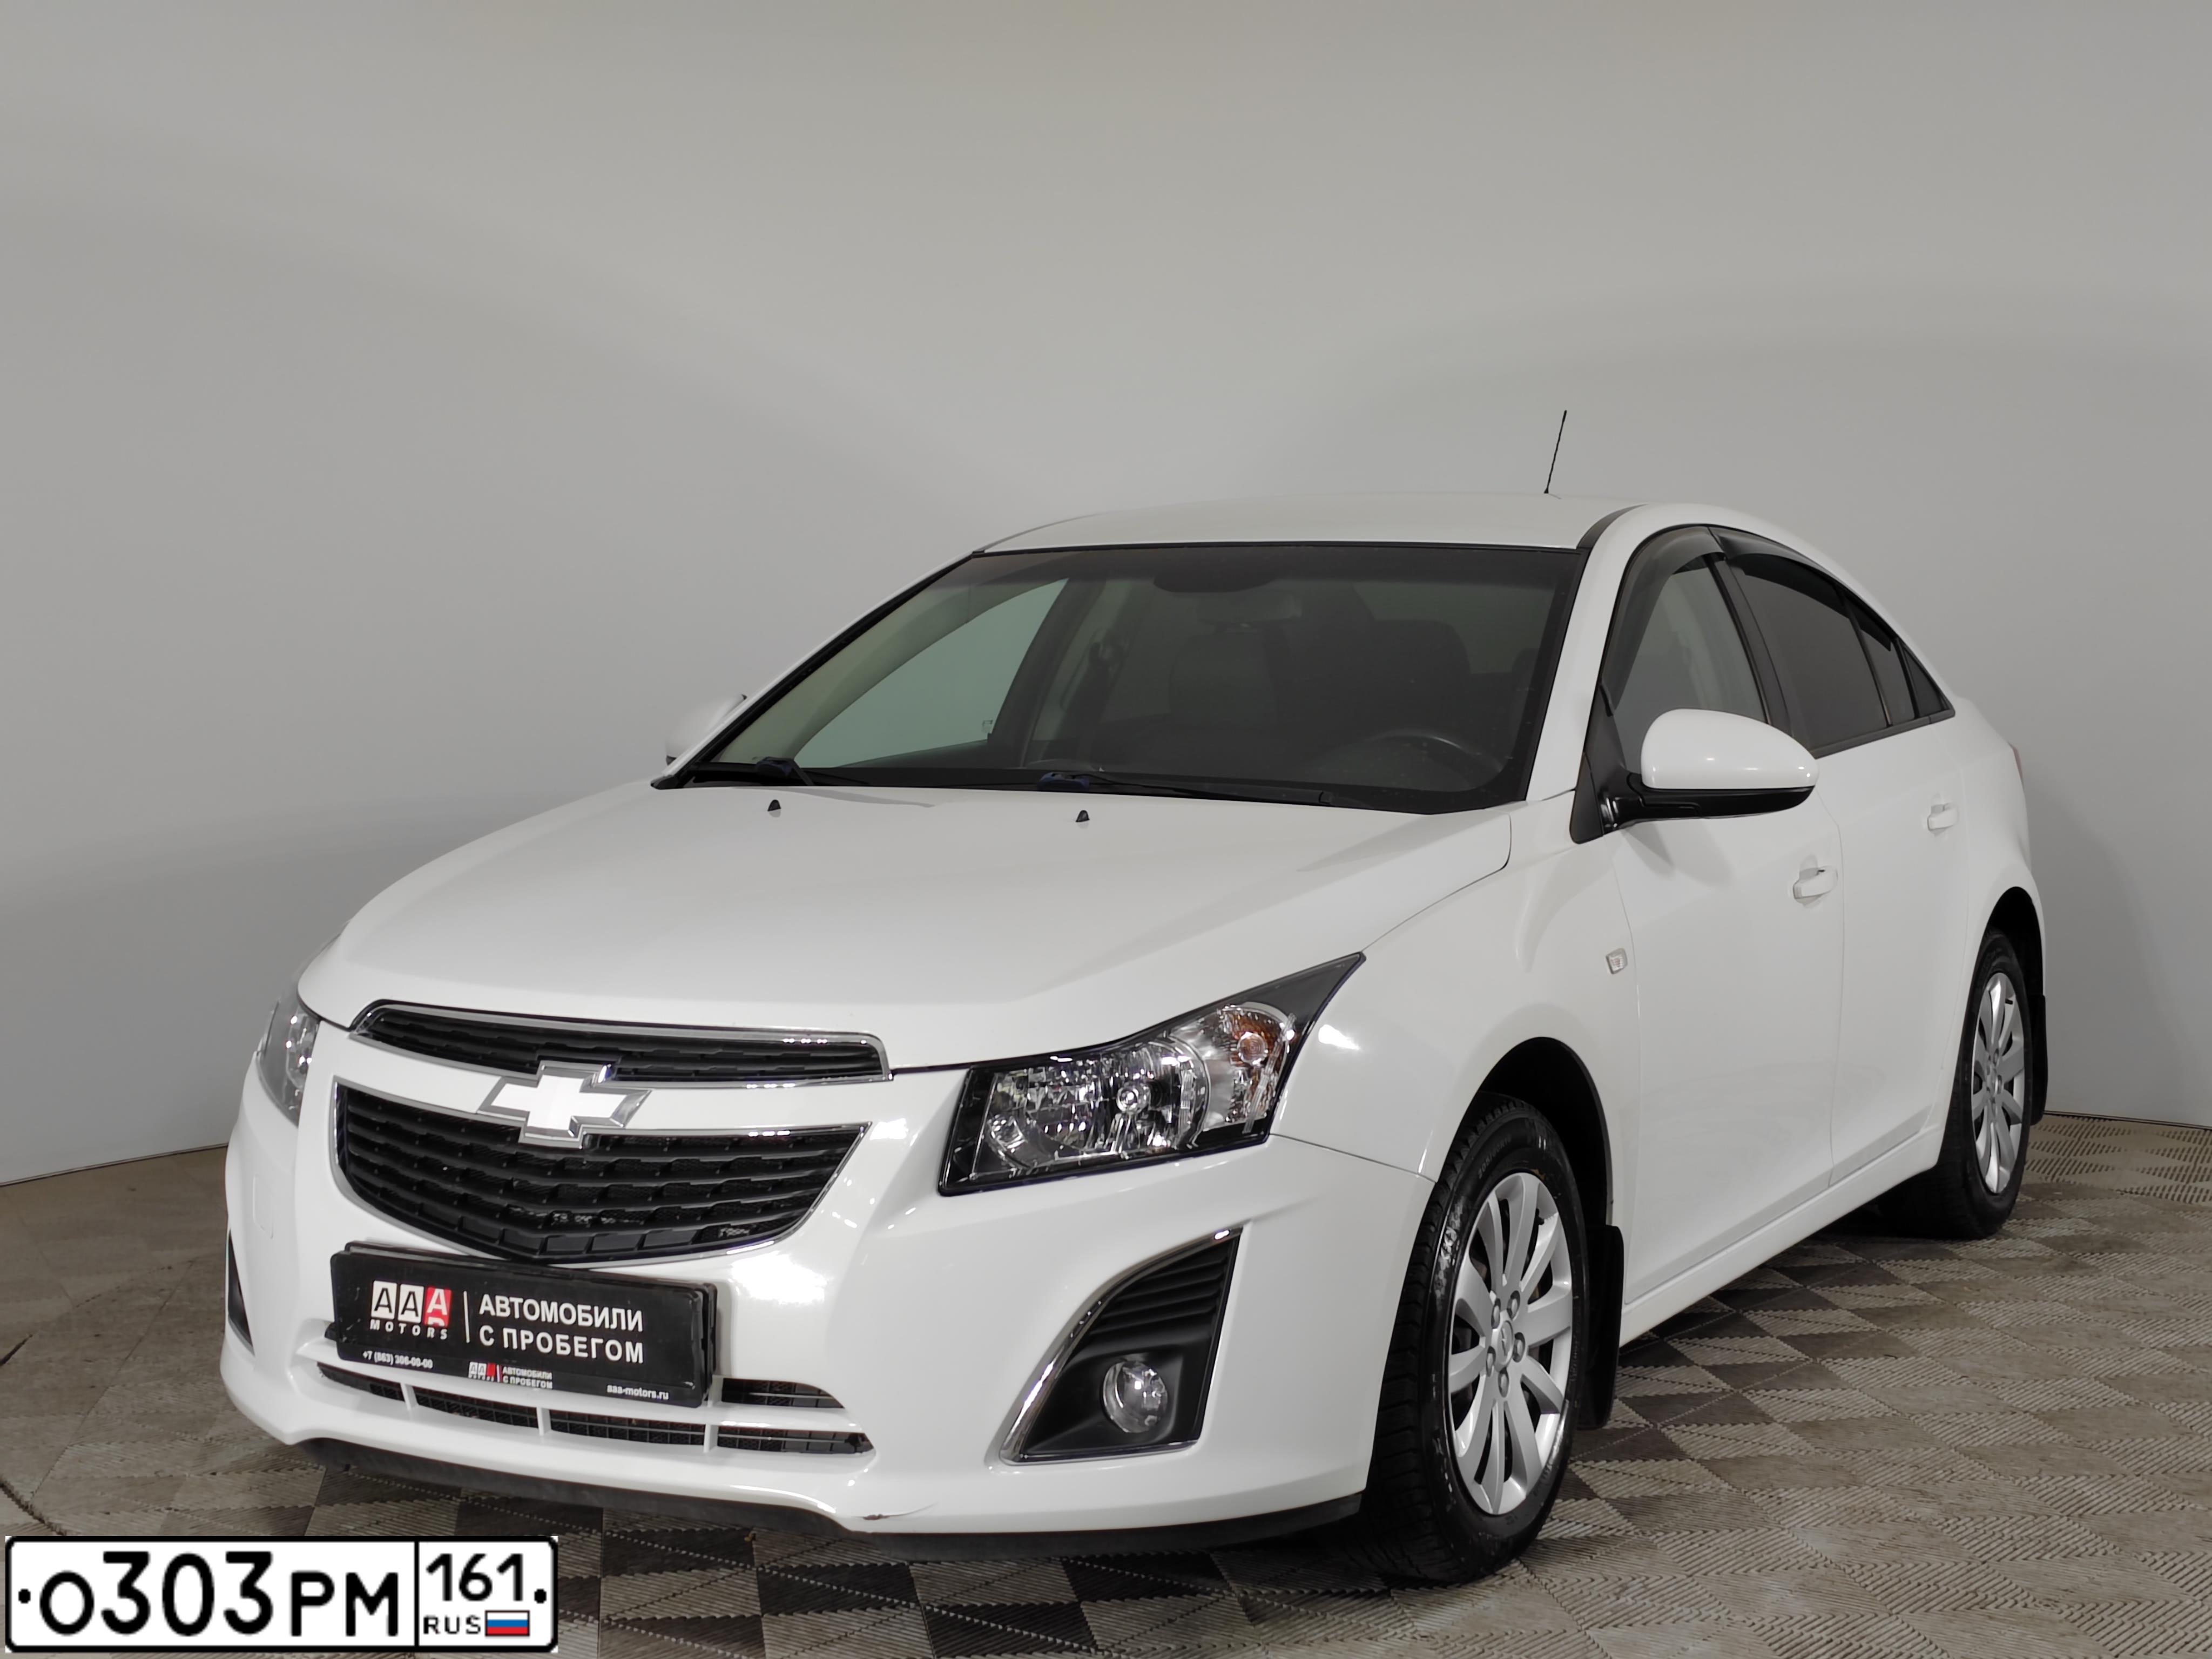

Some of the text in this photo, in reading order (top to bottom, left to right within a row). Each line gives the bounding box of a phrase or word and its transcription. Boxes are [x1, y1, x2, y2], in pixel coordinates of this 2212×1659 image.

[372, 1283, 449, 1318] AAA
[479, 1294, 643, 1332] АВТОМОБИЛИ
[370, 1319, 448, 1340] MOTORS
[480, 1325, 643, 1364] С ПРОБЕГОМ
[363, 1351, 373, 1360] +7
[503, 1366, 552, 1379] АВТОМОБИЛИ
[510, 1376, 552, 1388] ПРОБЕГОМ
[607, 1385, 669, 1400] aaa-motors.ru
